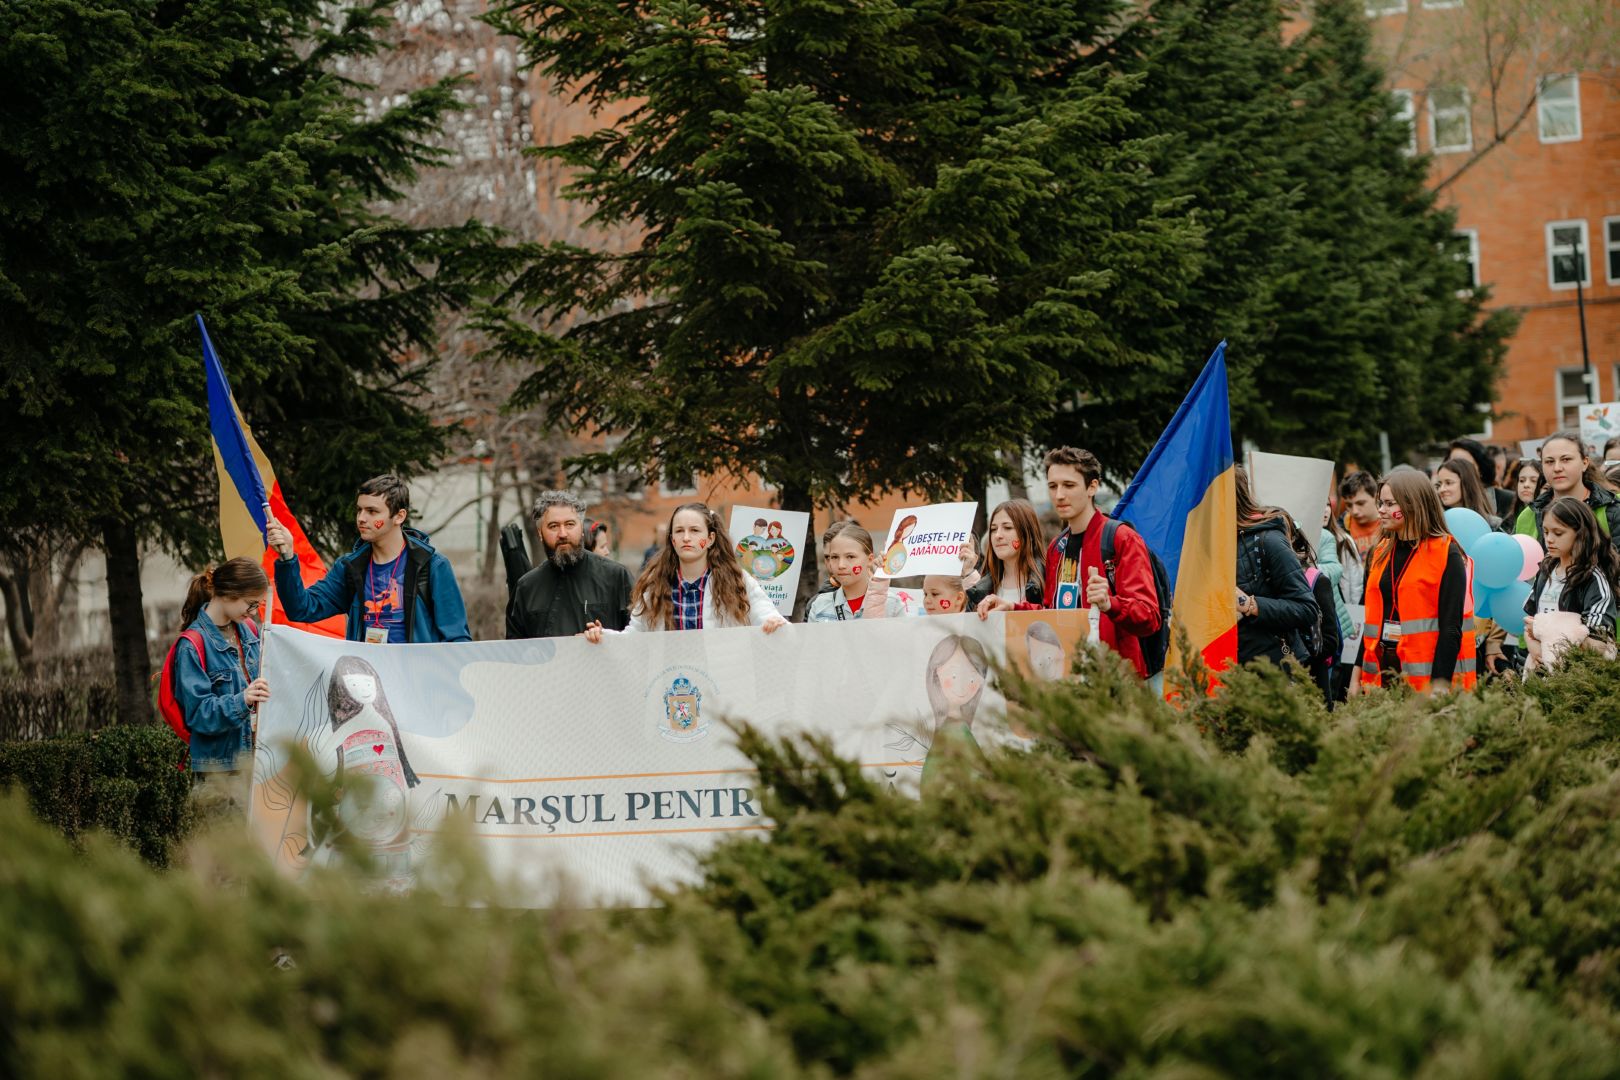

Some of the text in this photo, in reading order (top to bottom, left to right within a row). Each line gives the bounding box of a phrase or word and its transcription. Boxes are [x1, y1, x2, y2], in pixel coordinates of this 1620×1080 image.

[952, 532, 966, 542] PE
[767, 592, 788, 600] ărinți
[625, 786, 759, 822] PENTR
